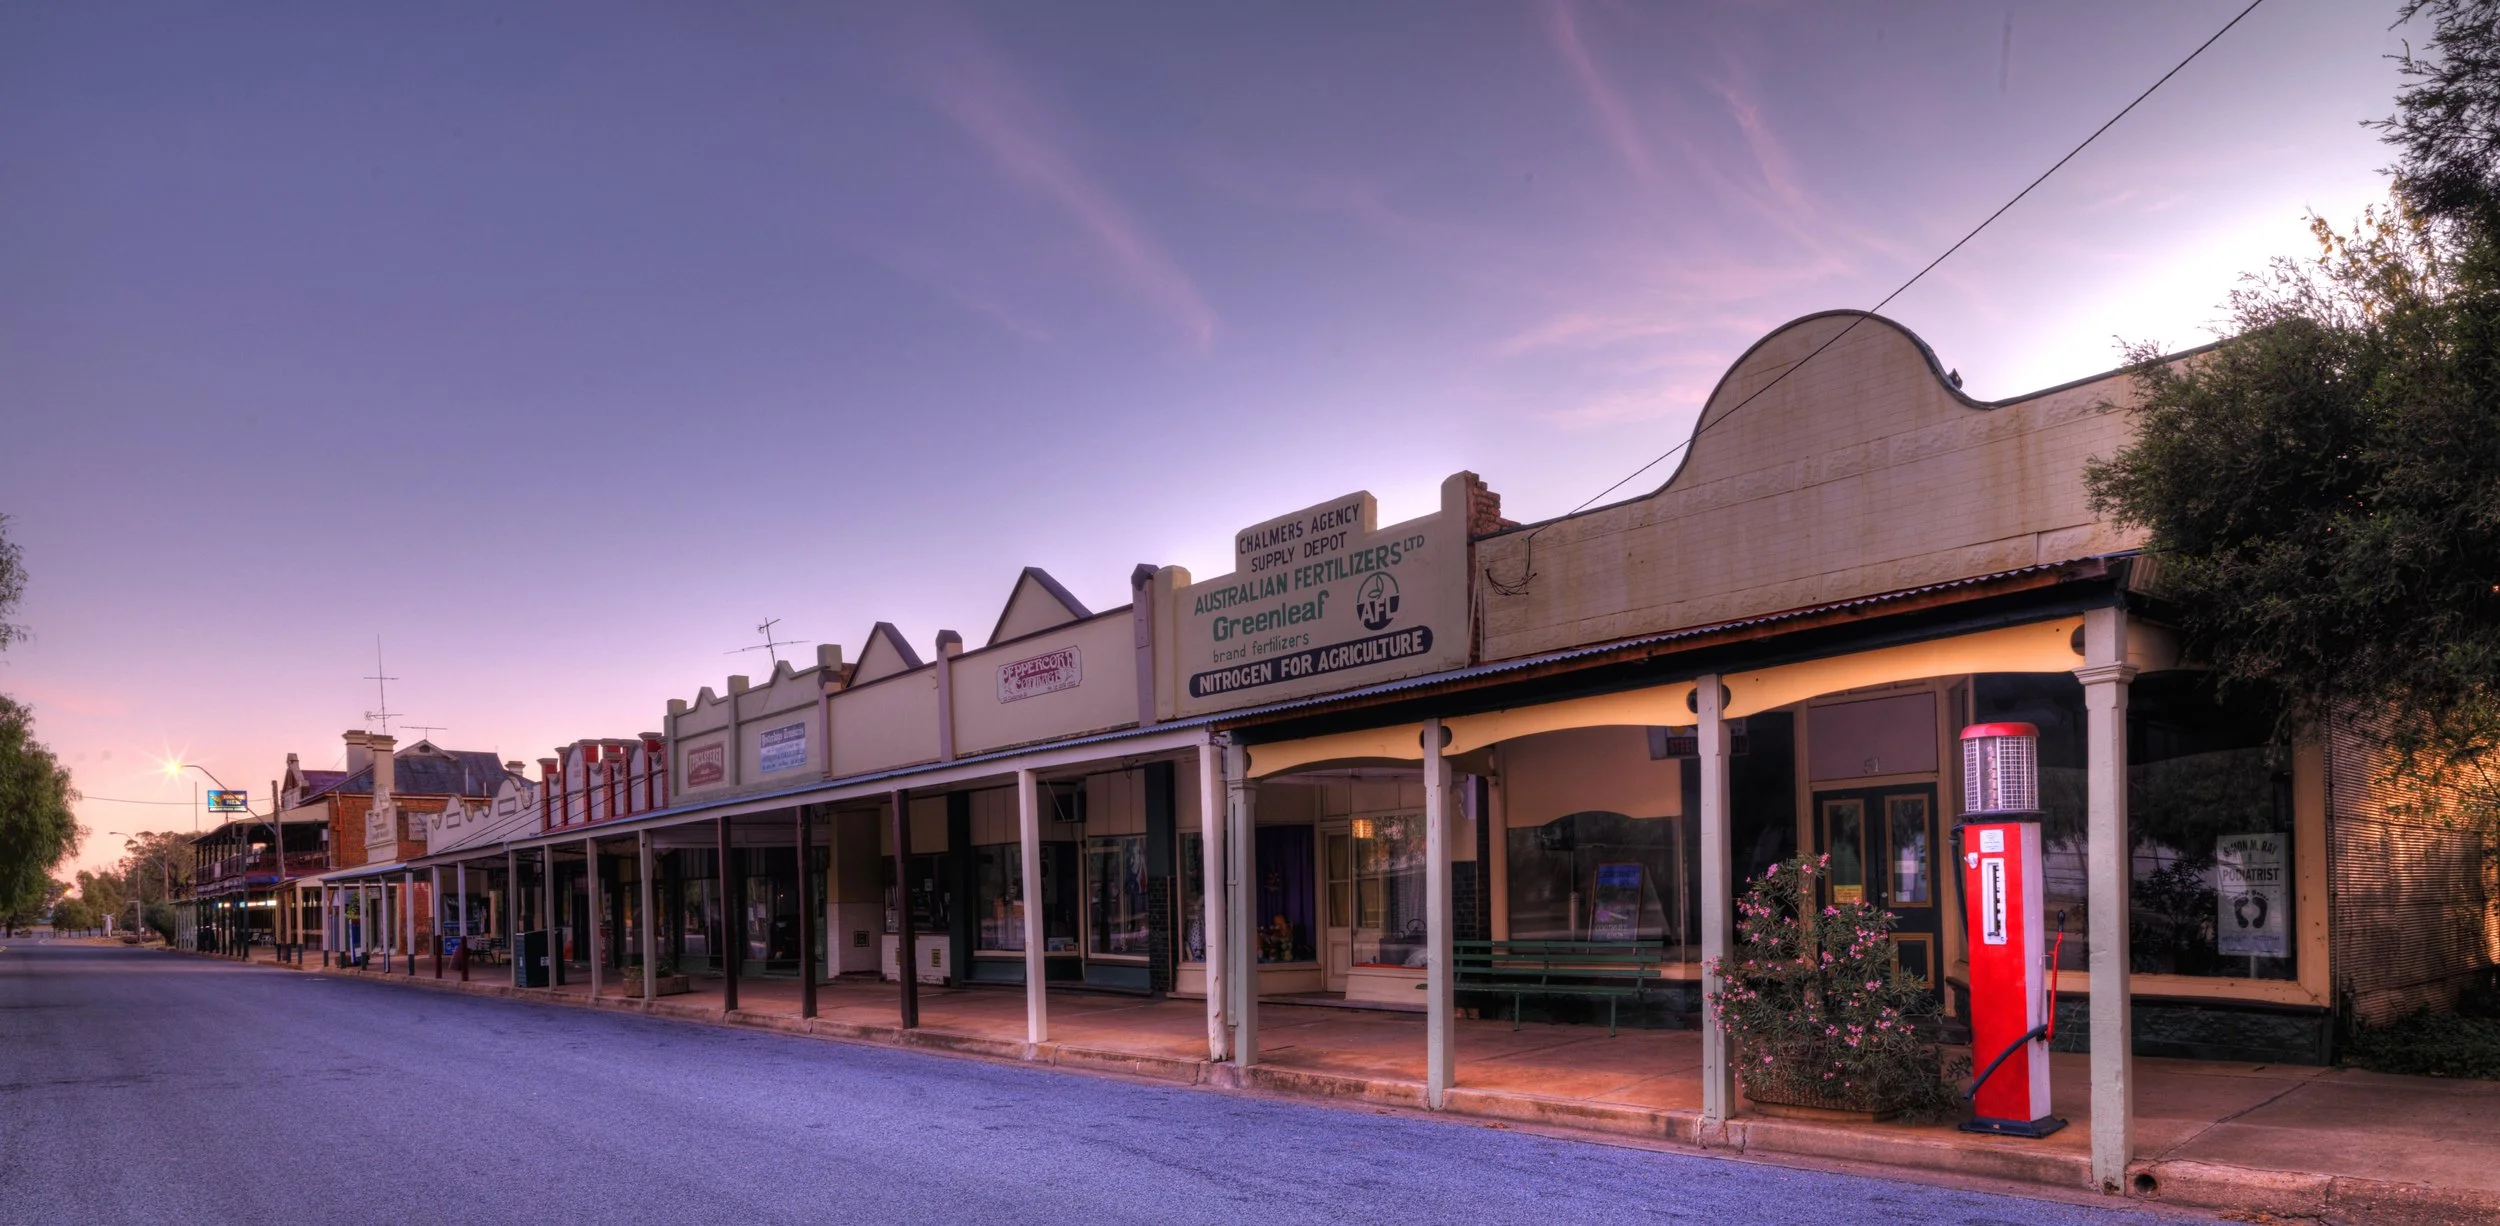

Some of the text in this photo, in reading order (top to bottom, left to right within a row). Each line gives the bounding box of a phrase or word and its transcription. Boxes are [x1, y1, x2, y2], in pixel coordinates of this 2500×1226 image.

[1239, 503, 1360, 554] CHALMERS AGENCY
[1251, 531, 1347, 573] SUPPLY DEPOT
[1194, 534, 1425, 616] AUSTRALIAN FERTILIZERS LTD
[1213, 590, 1330, 642] Greenleaf
[1361, 597, 1395, 624] AFL
[1002, 651, 1076, 682] PEPPERCORN
[1200, 630, 1424, 694] NITROGEN FOR AGRICULTURE
[1213, 633, 1310, 664] brand fertilizers
[2261, 840, 2278, 856] RAY
[2222, 867, 2280, 882] PODIATRIST
